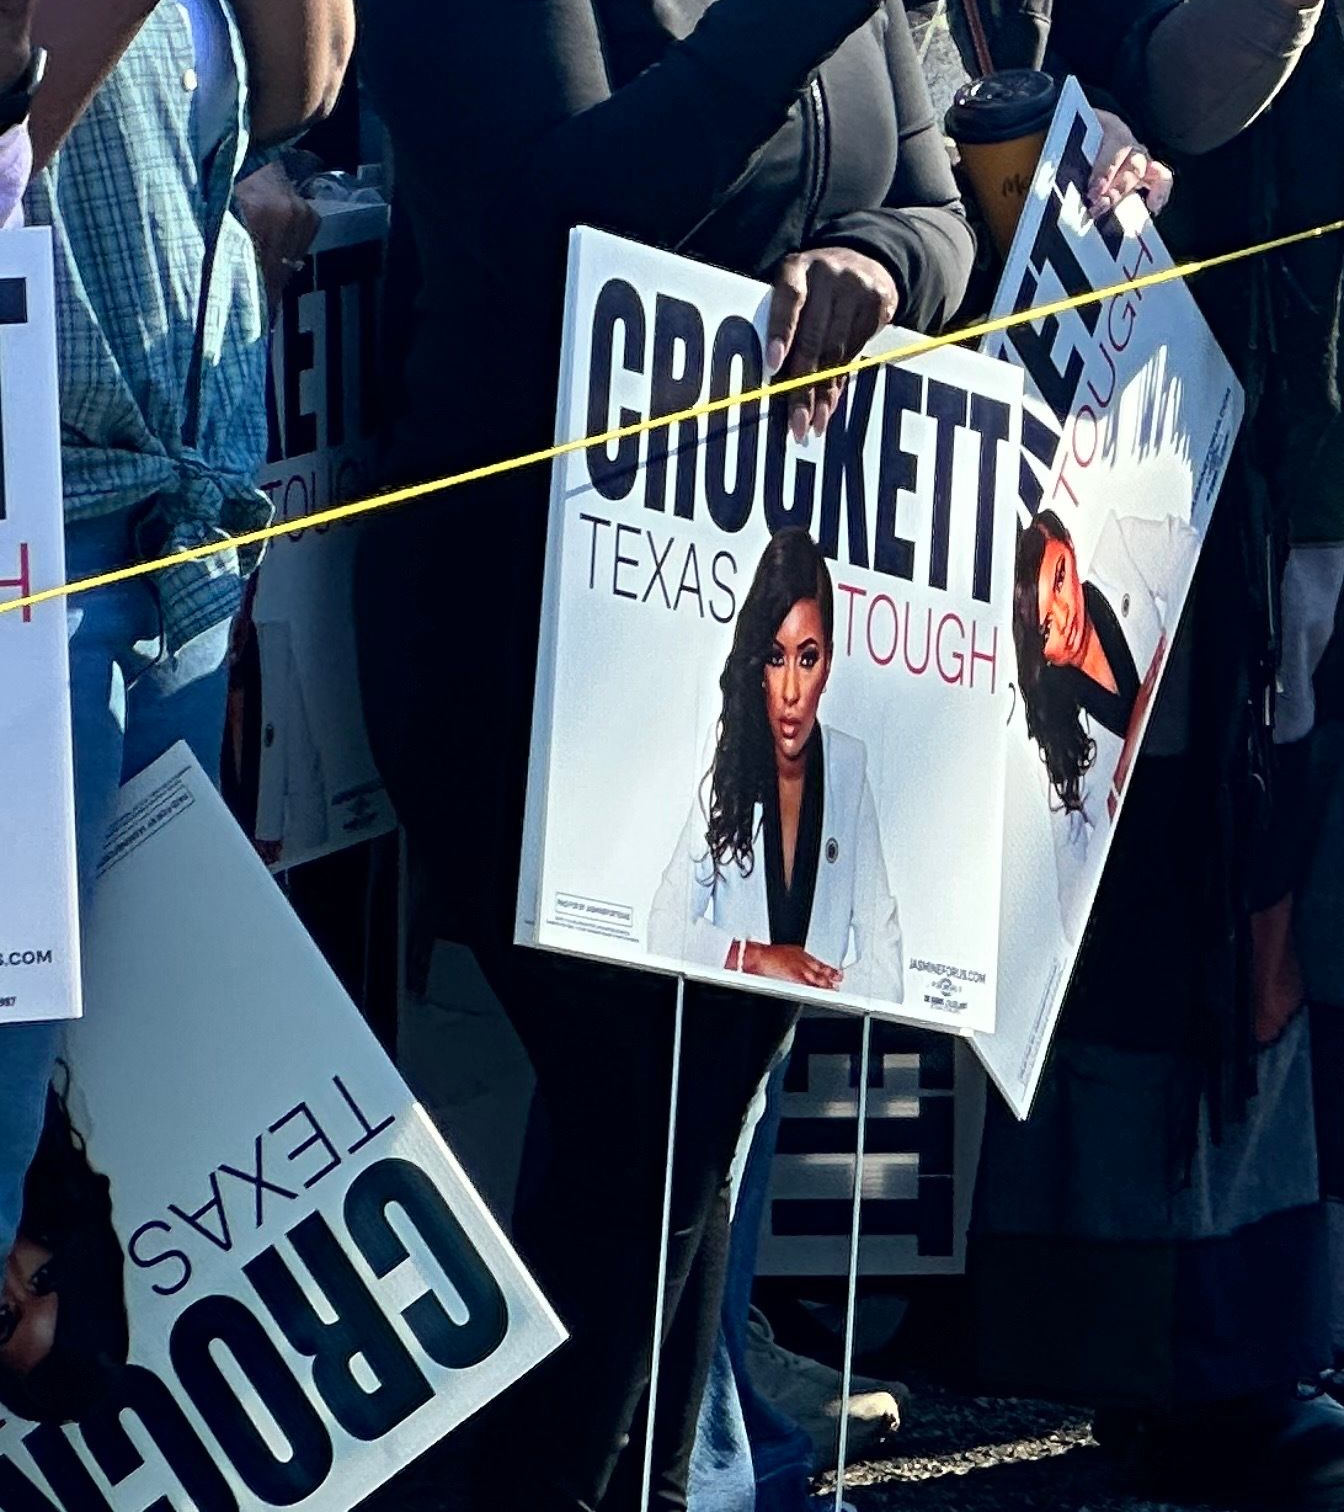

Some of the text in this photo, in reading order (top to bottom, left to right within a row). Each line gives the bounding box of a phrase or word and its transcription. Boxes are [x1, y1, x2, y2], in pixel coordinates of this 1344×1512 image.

[585, 278, 1011, 604] CROCKETT
[1051, 231, 1155, 507] TOUGH
[579, 512, 998, 695] TEXAS TOUGH
[127, 1074, 397, 1296] TEXAS
